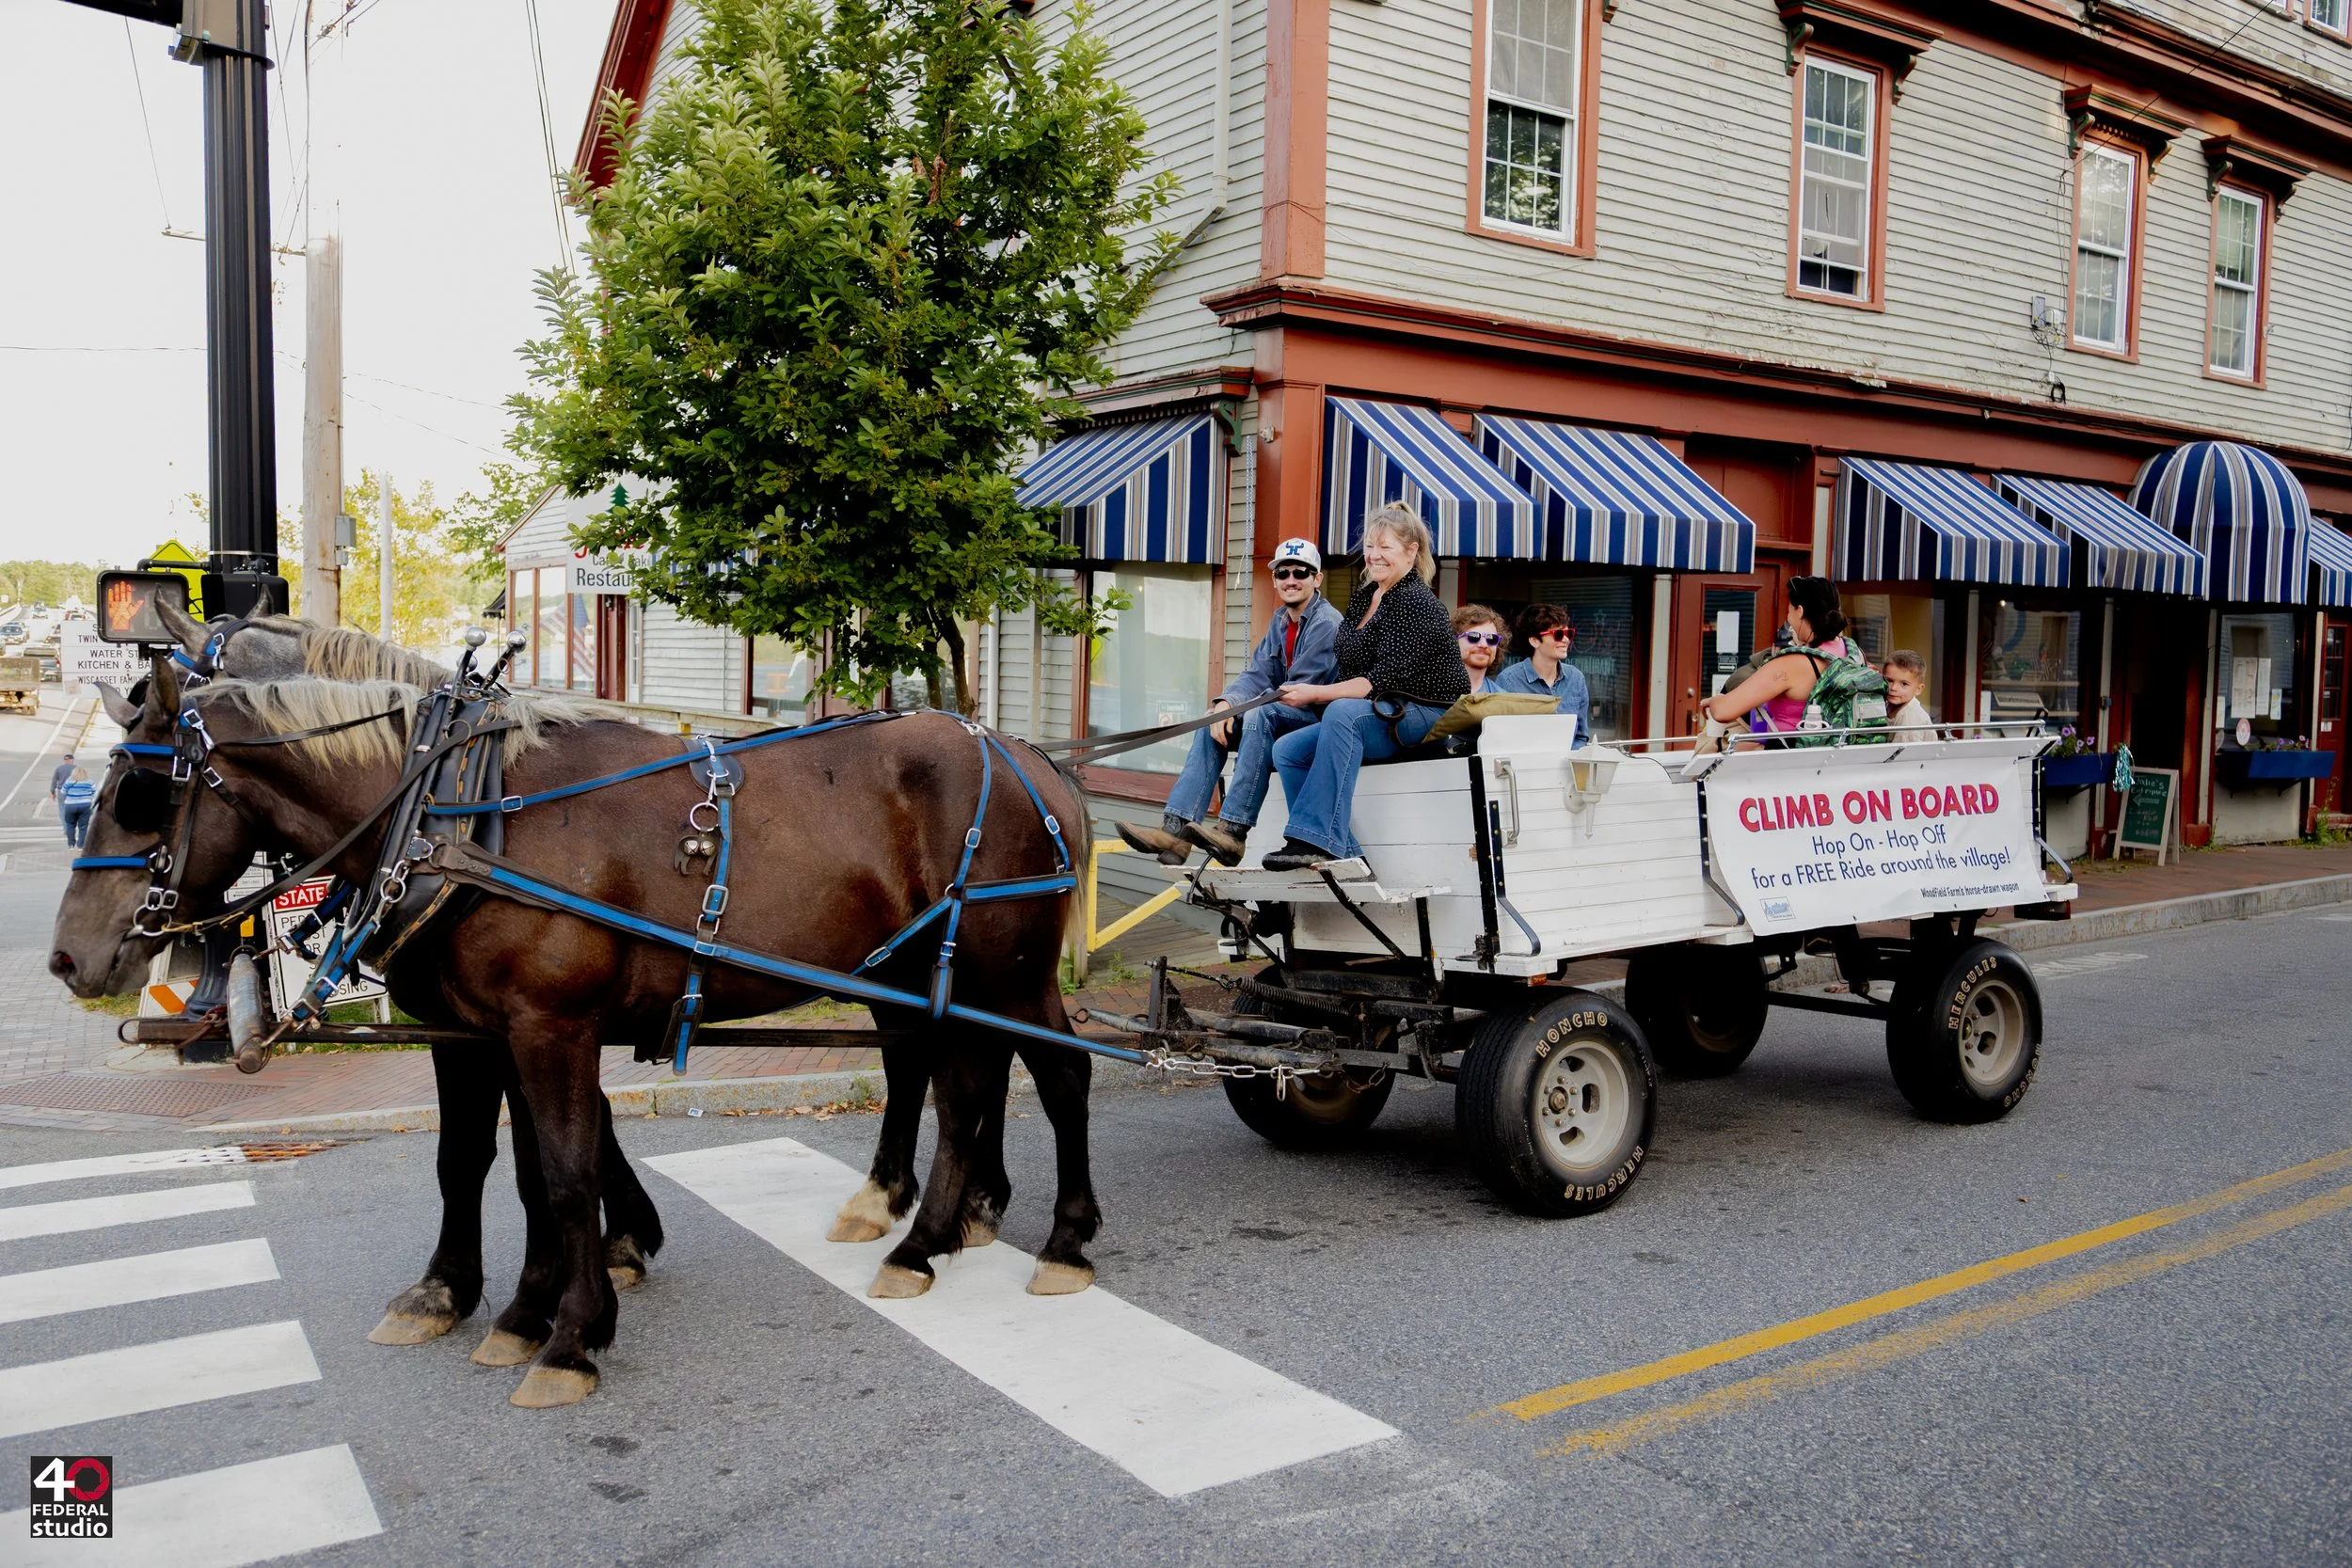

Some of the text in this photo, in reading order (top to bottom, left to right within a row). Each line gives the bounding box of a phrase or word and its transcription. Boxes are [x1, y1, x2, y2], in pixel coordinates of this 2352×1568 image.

[577, 568, 630, 587] Restau
[137, 660, 151, 669] BA
[1739, 784, 1999, 832] CLIMB ON BOARD
[1812, 835, 1845, 859] Hop
[1850, 832, 1875, 851] On
[1886, 830, 1918, 851] Hop
[1922, 824, 1946, 844] Off
[1751, 846, 2010, 889] for a FREE Ride around the village!
[279, 887, 325, 905] STATE
[1947, 886, 1965, 896] Farm's
[1964, 884, 2000, 895] horse-drawn
[2000, 883, 2020, 893] wagon
[1948, 956, 1997, 1030] HERCULES
[1535, 1011, 1608, 1058] HONCHO
[2004, 1043, 2042, 1107] HONCHO
[1565, 1146, 1644, 1202] HERCULES
